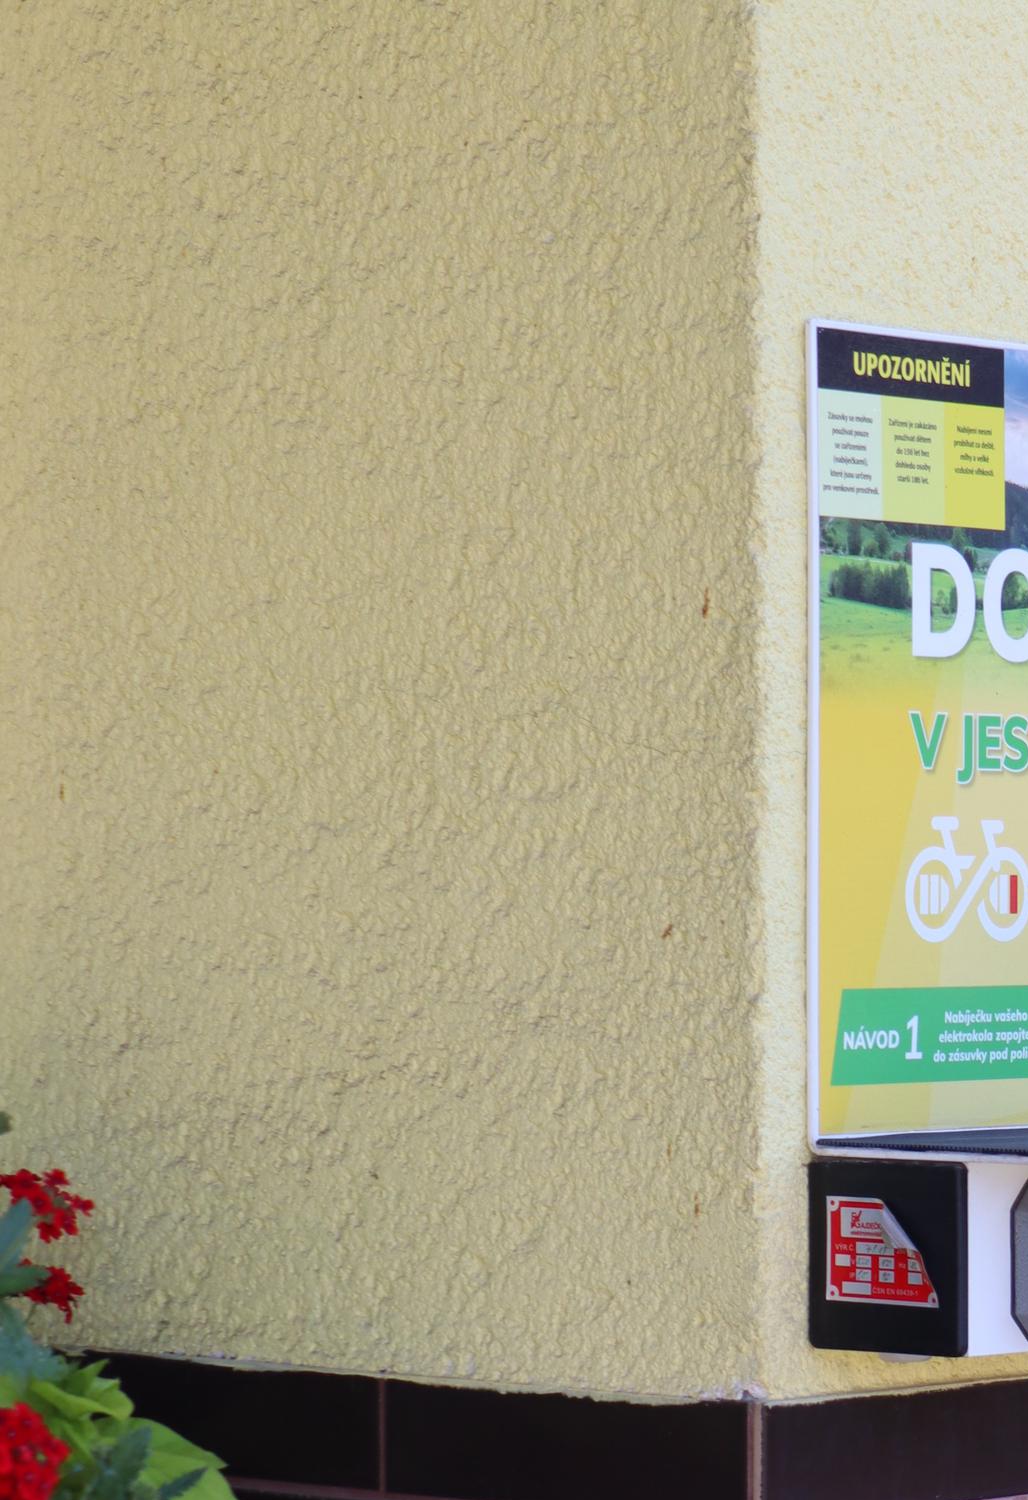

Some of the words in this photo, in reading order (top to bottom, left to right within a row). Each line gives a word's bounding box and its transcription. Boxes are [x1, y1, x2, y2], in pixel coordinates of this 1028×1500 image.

[853, 351, 970, 387] UPOZORNĚNÍ
[909, 712, 948, 771] V
[944, 1010, 991, 1026] Nabíječku
[995, 1008, 1028, 1022] vašeho
[843, 1026, 900, 1050] NÁVOD
[905, 1015, 923, 1060] 1
[939, 1030, 993, 1043] elektrokola
[934, 1050, 945, 1063] do
[949, 1049, 986, 1064] zásuvky
[990, 1047, 1008, 1064] pod
